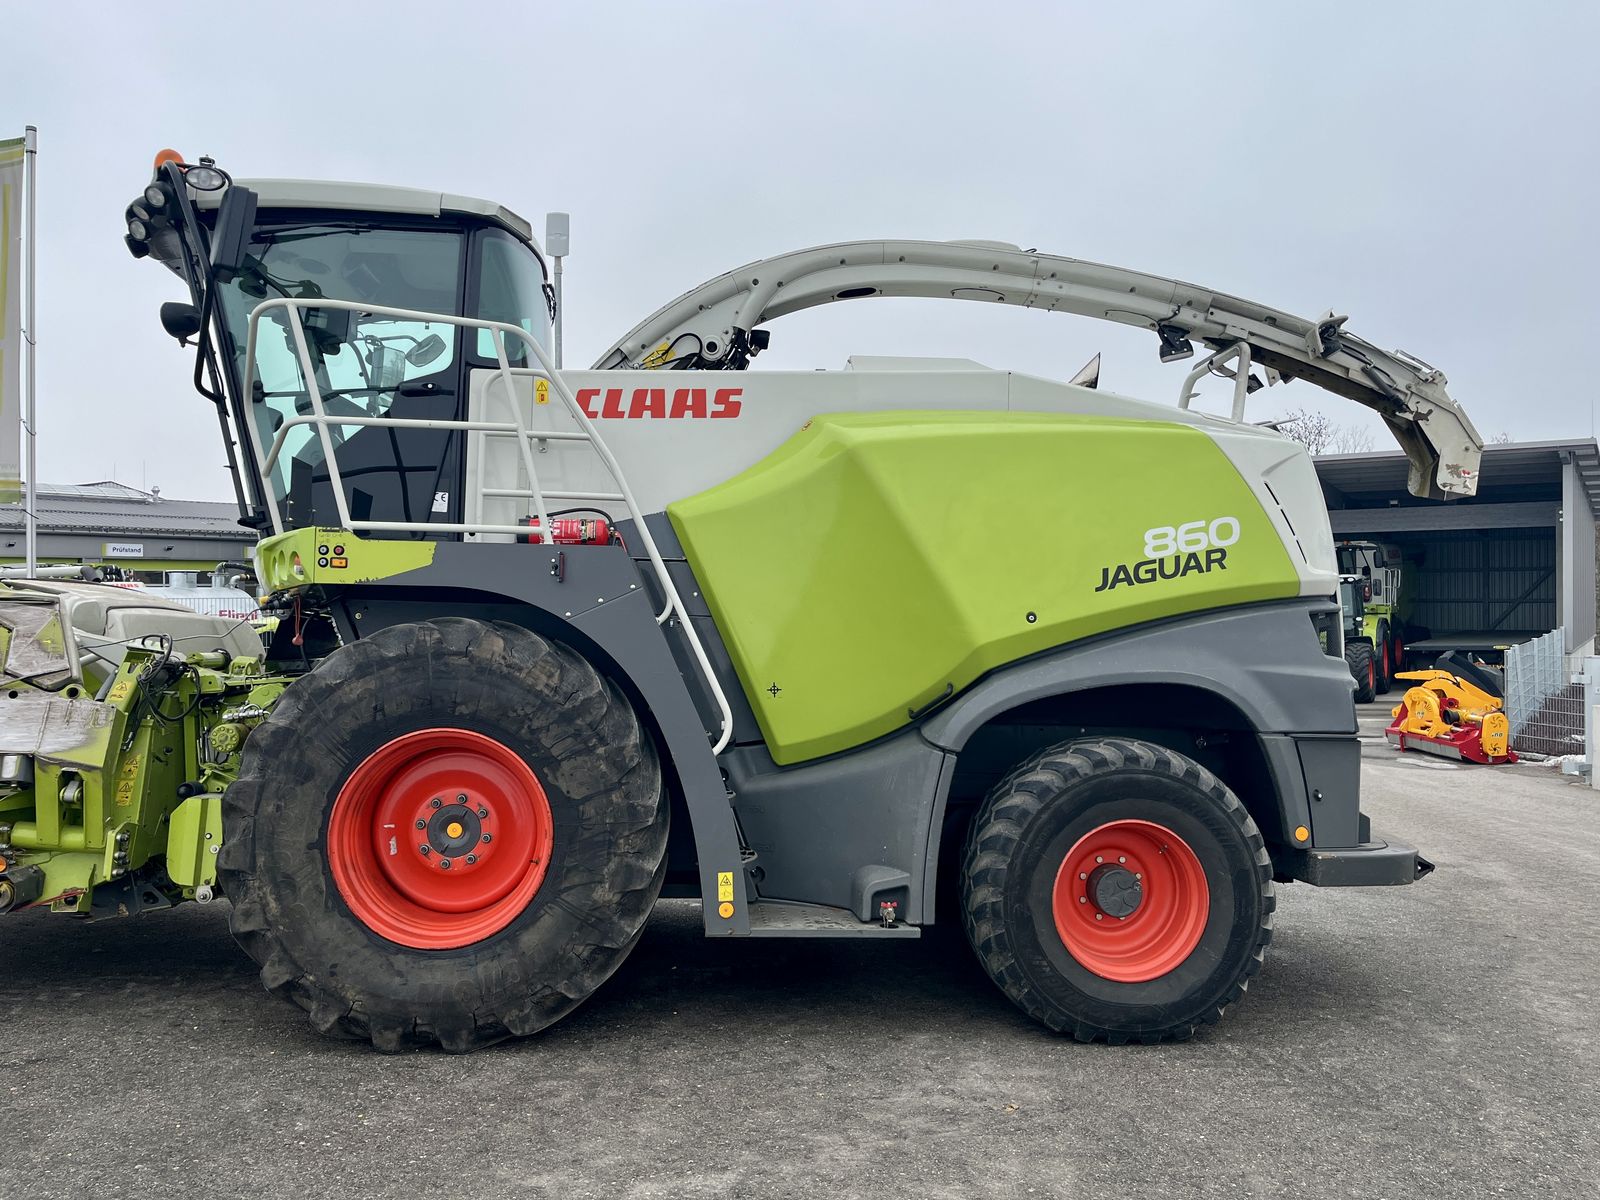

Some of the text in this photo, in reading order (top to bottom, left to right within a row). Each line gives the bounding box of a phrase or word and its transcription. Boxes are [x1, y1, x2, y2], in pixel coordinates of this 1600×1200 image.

[575, 388, 743, 418] CLAAS
[112, 546, 142, 554] Prüfstand
[1143, 516, 1241, 559] 860
[1094, 547, 1228, 593] JAGUAR
